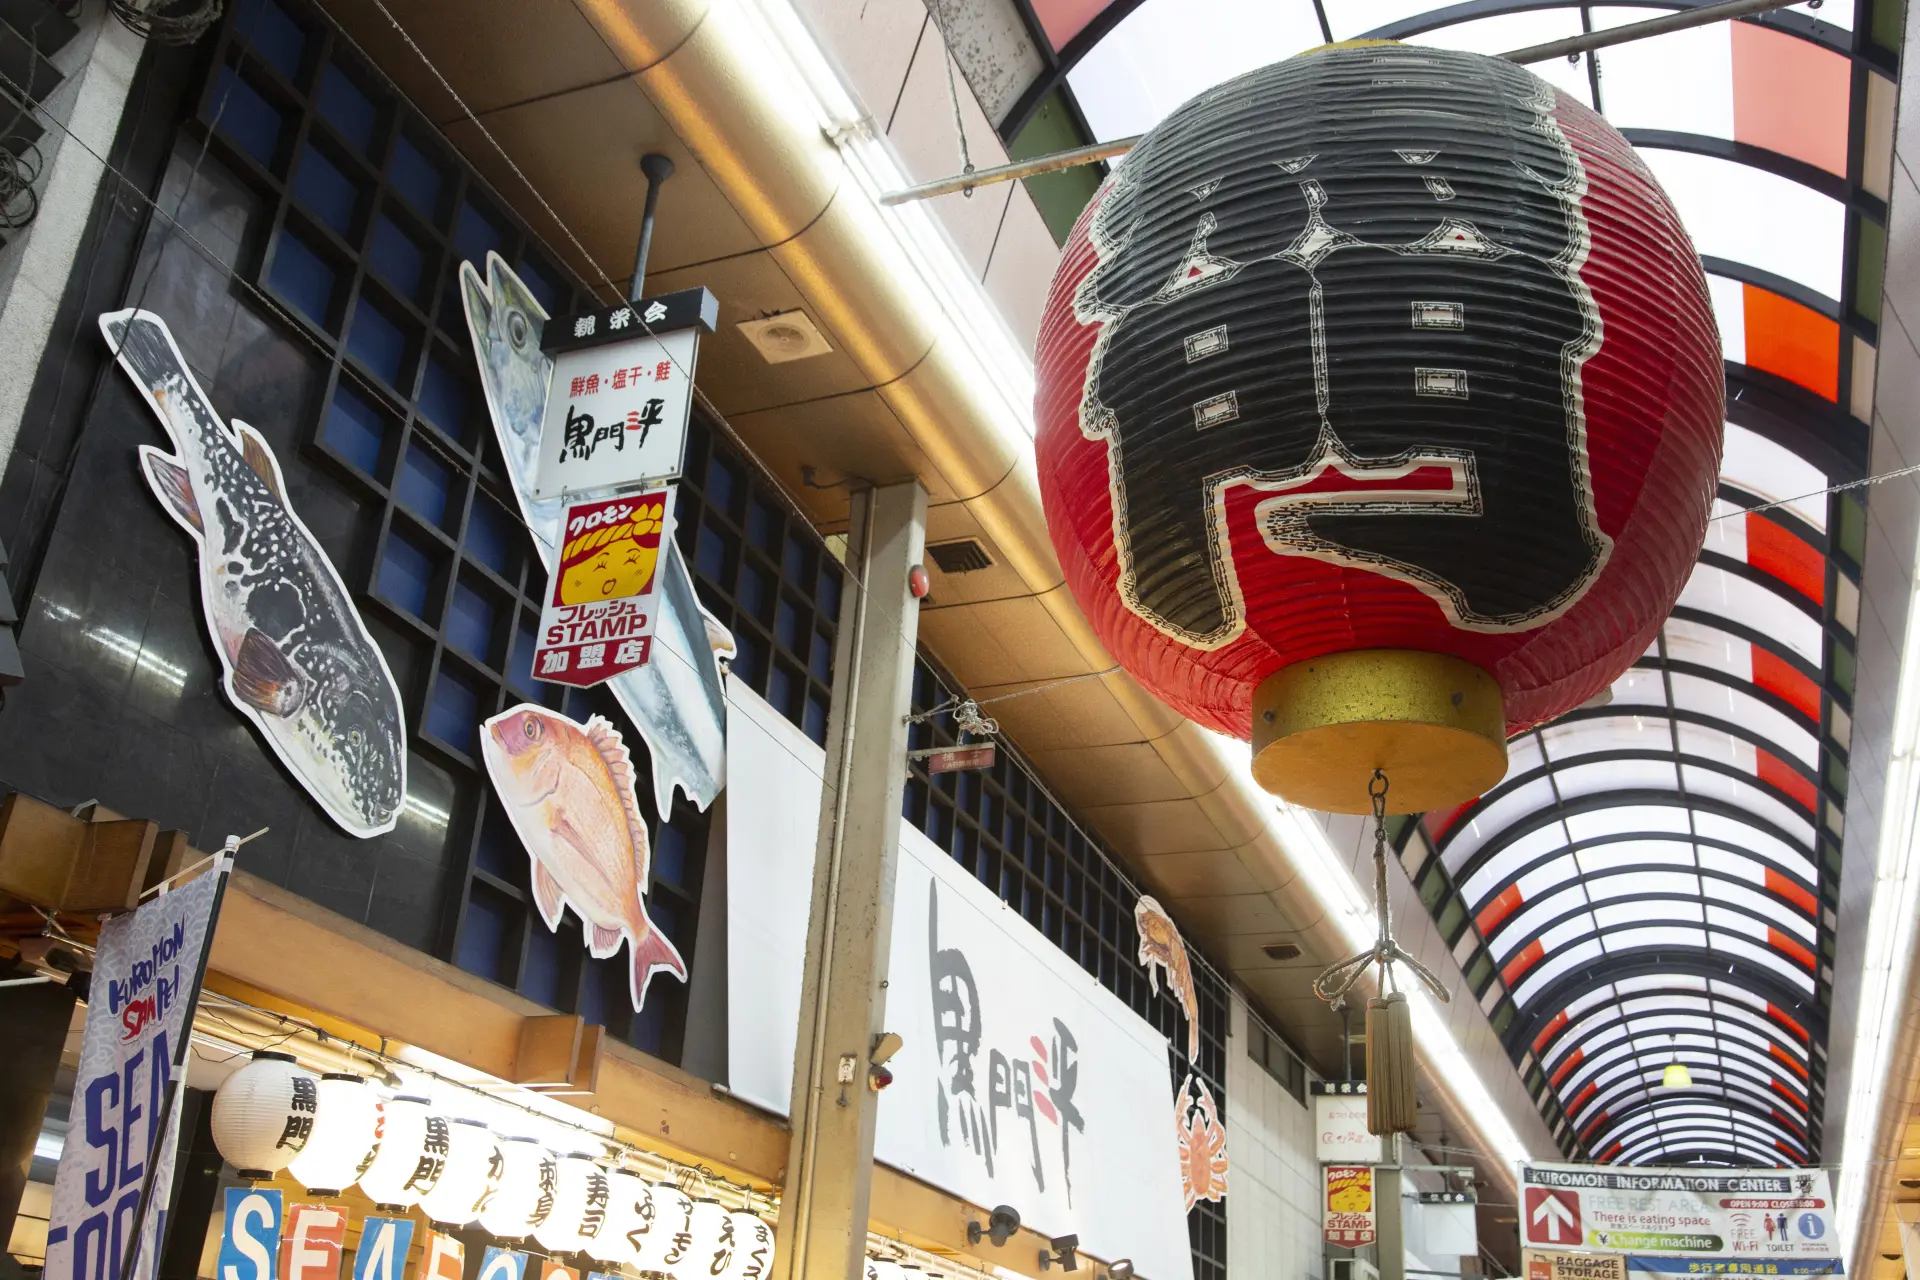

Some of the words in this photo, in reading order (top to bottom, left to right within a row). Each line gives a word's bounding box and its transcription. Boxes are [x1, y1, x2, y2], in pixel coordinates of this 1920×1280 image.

[573, 301, 668, 338] 親栄会
[558, 398, 665, 463] 黒門三平
[569, 503, 633, 536] クロモン
[557, 600, 637, 624] フレッシュ
[546, 613, 647, 646] STAMP
[540, 639, 644, 674] 加盟店
[108, 912, 186, 1015] KUROMON
[275, 1076, 318, 1153] 黒門
[403, 1116, 450, 1196] 黒門
[1328, 1171, 1356, 1181] クロモン
[1532, 1172, 1608, 1188] KUROMON
[1616, 1176, 1720, 1192] INFORMATION
[1726, 1178, 1783, 1192] CENTER
[525, 1157, 558, 1229] 刺身
[577, 1172, 610, 1240] 寿司
[1588, 1194, 1625, 1211] FREE
[1630, 1196, 1664, 1212] REST
[1668, 1198, 1709, 1213] AREA
[1730, 1200, 1750, 1208] OPEN
[1751, 1200, 1769, 1208] 9:00
[1771, 1200, 1796, 1208] CLOSE
[1327, 1219, 1372, 1229] STAMP
[1332, 1212, 1366, 1220] フレッシュ
[1593, 1210, 1625, 1223] There
[1628, 1211, 1637, 1223] is
[1640, 1212, 1675, 1227] eating
[1678, 1216, 1711, 1227] space
[1327, 1230, 1372, 1241] 加盟店
[1612, 1231, 1657, 1247] Change
[1659, 1235, 1712, 1248] machine
[1730, 1229, 1756, 1239] FREE
[1732, 1240, 1758, 1251] Wi-Fi
[1766, 1244, 1794, 1252] TOILET
[1556, 1256, 1619, 1269] BAGGAGE
[1557, 1266, 1620, 1280] STORAGE
